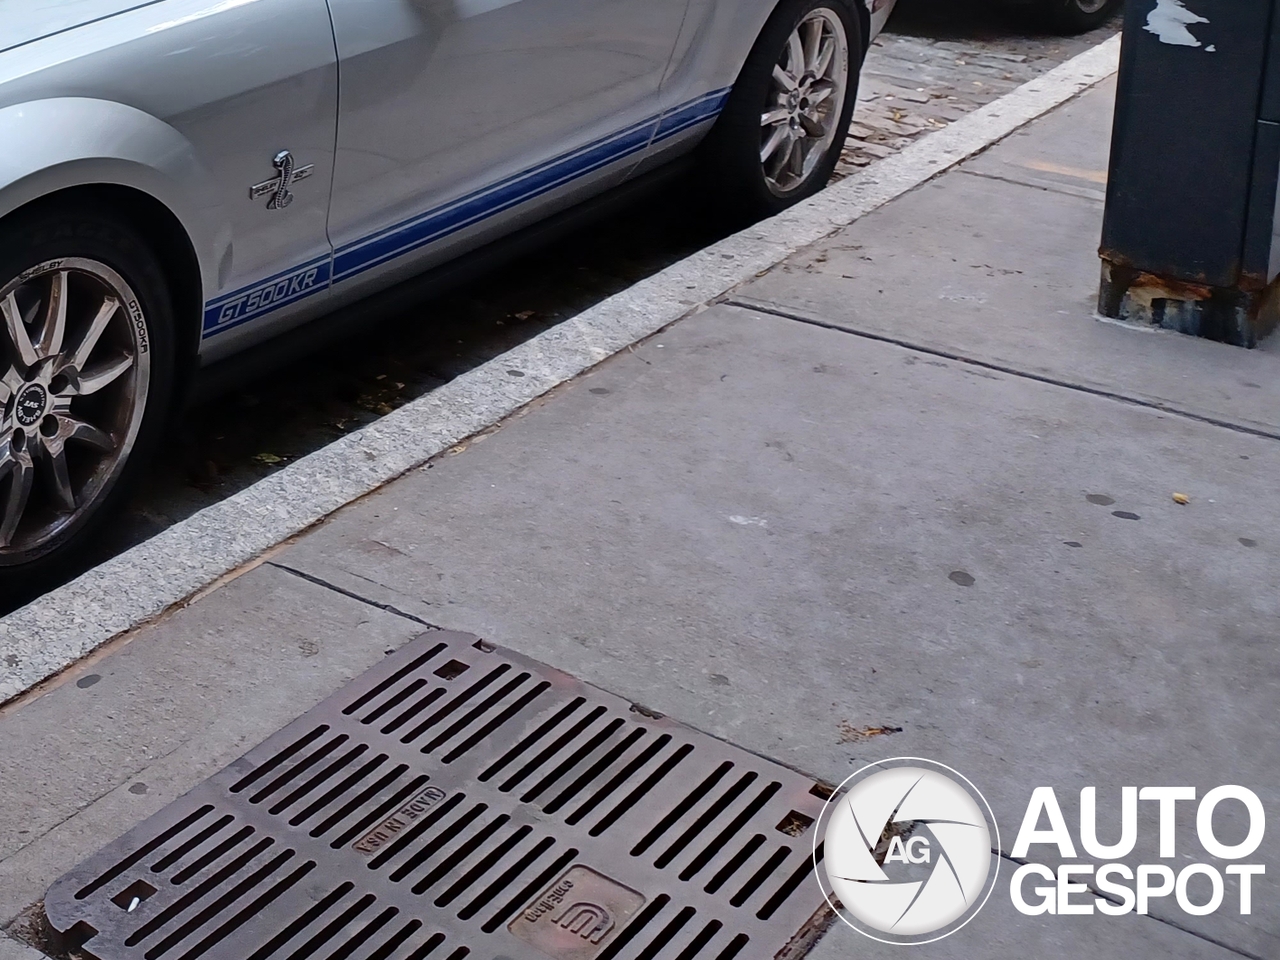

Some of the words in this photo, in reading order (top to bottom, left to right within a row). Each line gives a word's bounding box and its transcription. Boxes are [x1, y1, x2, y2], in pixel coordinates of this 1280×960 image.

[401, 790, 441, 820] MADE
[384, 818, 406, 833] IN
[356, 831, 389, 853] USA
